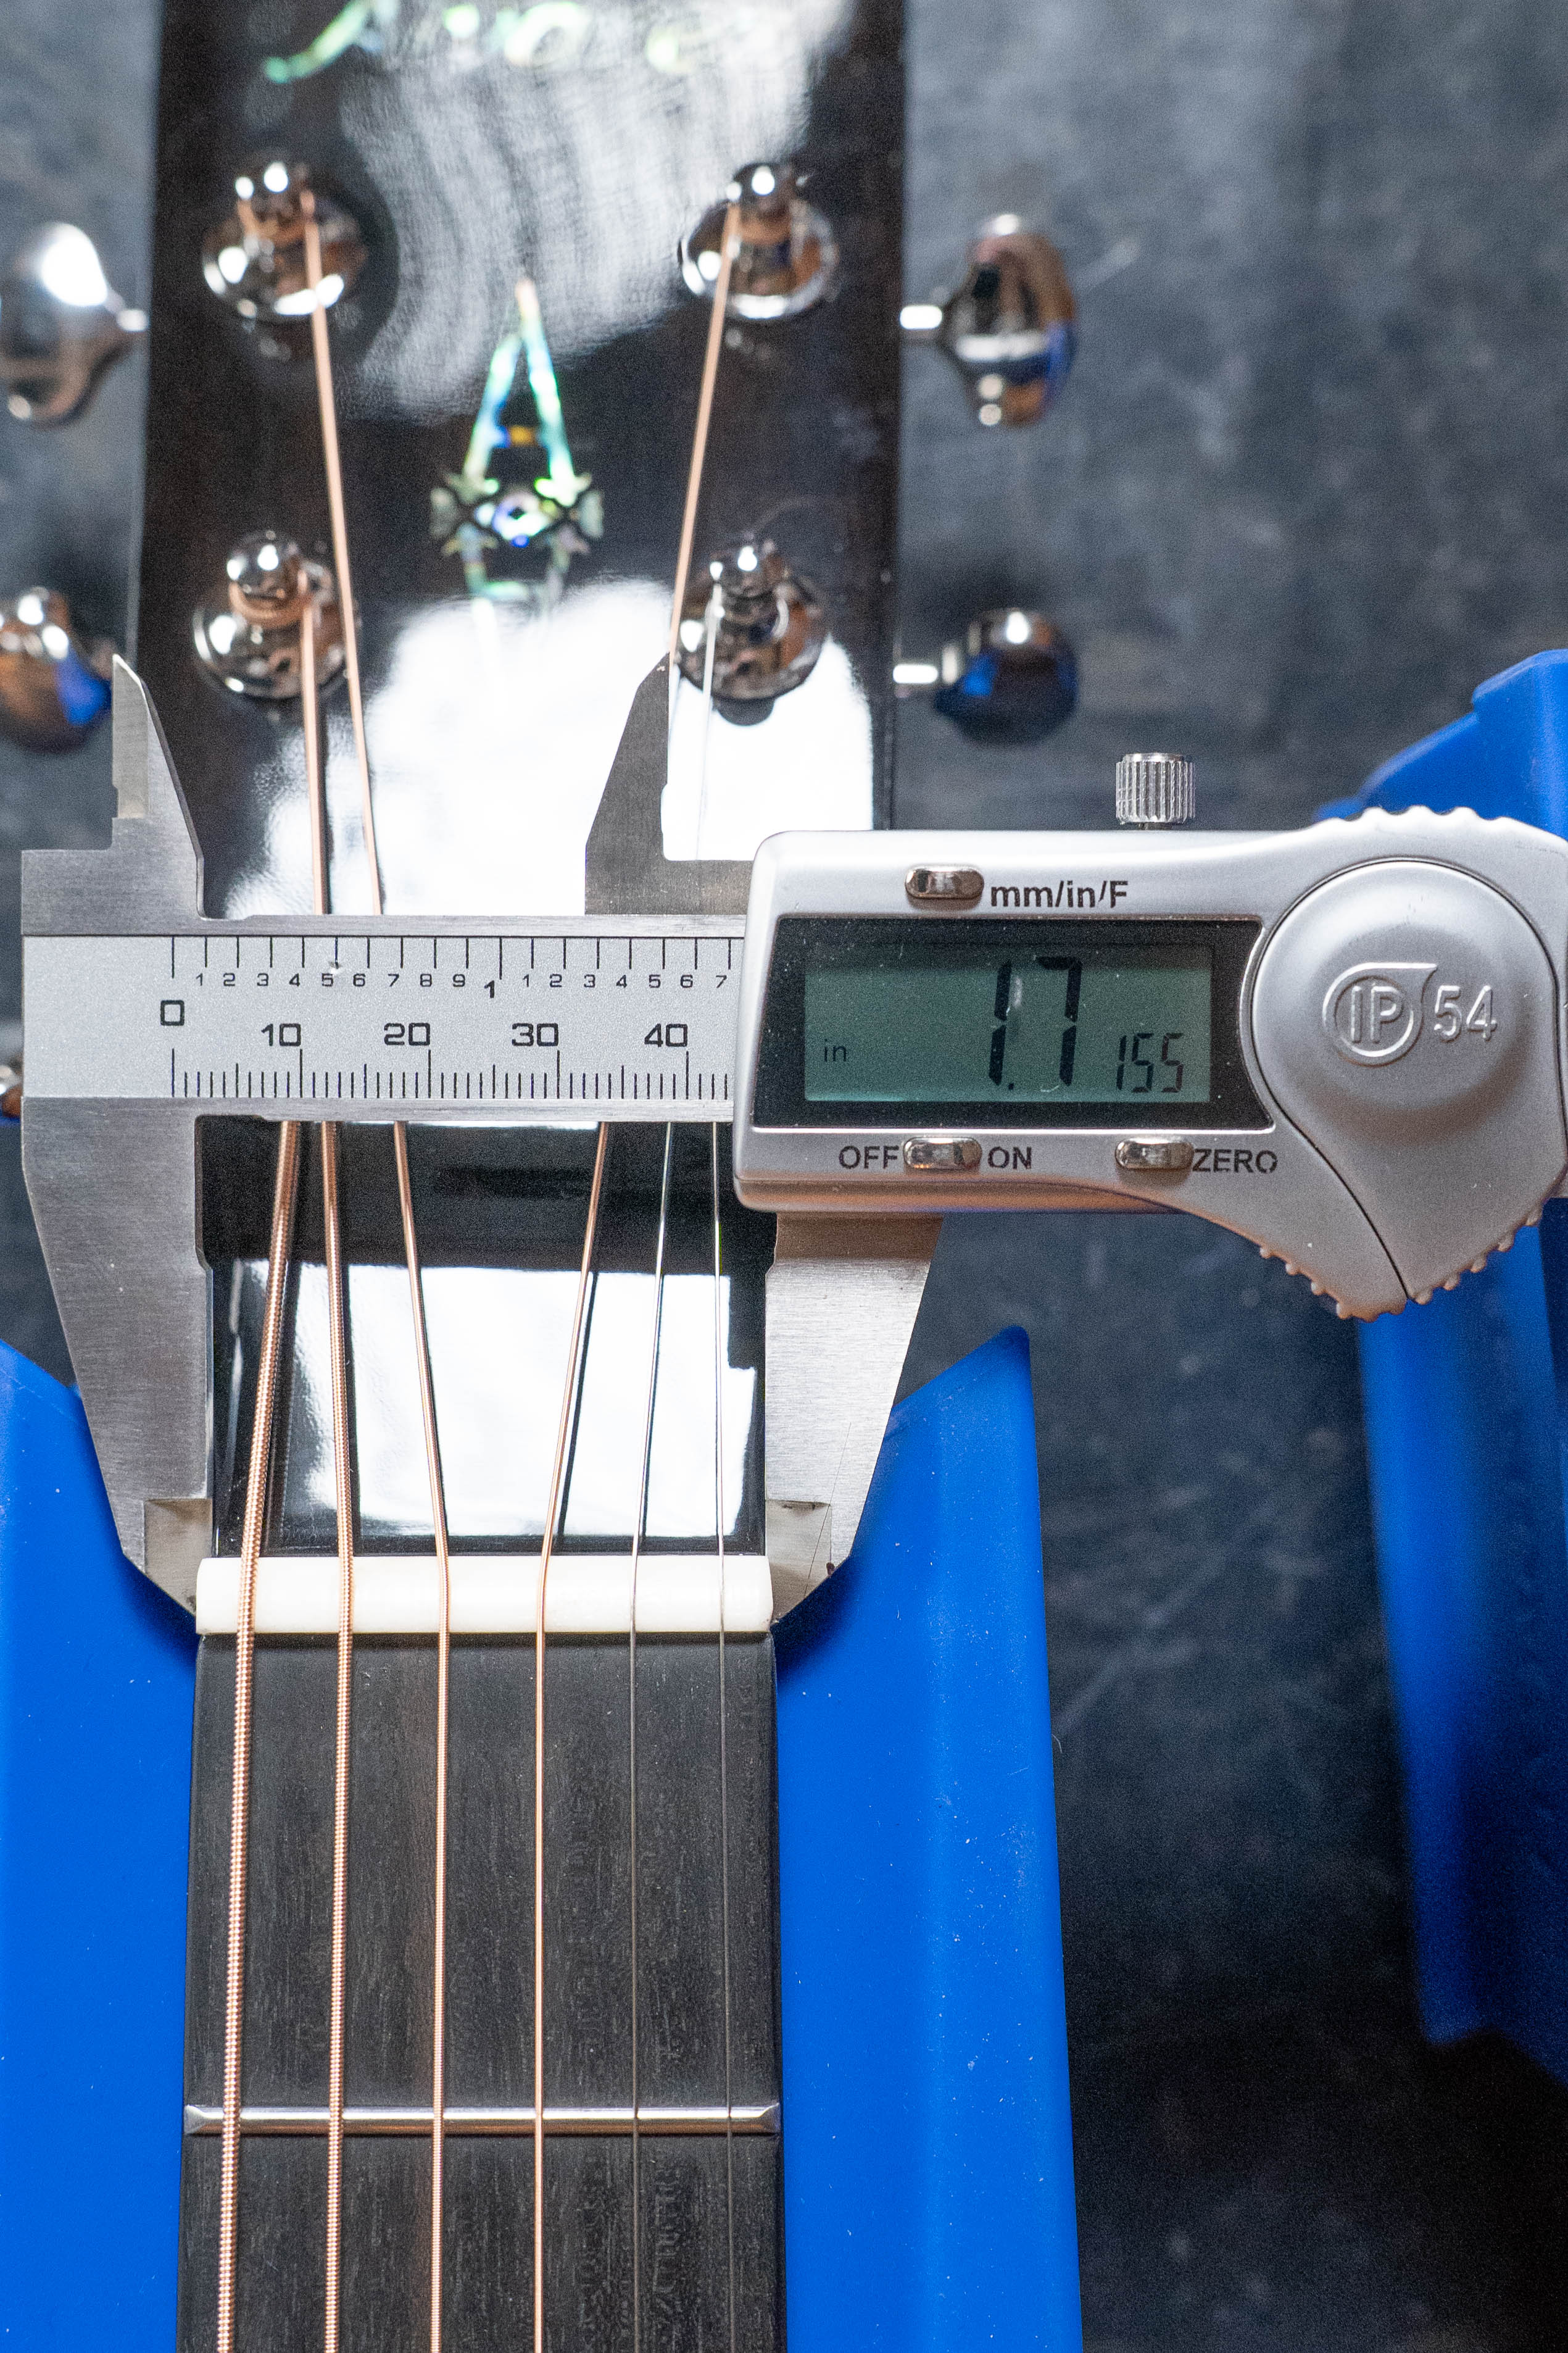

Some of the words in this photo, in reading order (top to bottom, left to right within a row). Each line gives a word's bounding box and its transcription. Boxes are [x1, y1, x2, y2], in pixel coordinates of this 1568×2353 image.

[990, 880, 1129, 909] mm/in/F
[195, 972, 204, 986] 1
[222, 972, 236, 988] 2
[256, 972, 270, 987] 3
[288, 973, 301, 988] 4
[321, 972, 334, 988] 5
[352, 973, 367, 988] 6
[388, 973, 400, 988] 7
[419, 973, 433, 988] 8
[452, 973, 466, 988] 9
[484, 980, 496, 999] 1
[522, 973, 529, 988] 1
[549, 973, 563, 988] 2
[583, 973, 596, 988] 3
[615, 974, 628, 989] 4
[648, 973, 662, 989] 5
[679, 974, 694, 989] 6
[715, 974, 728, 989] 7
[159, 999, 185, 1027] 0
[260, 1023, 302, 1047] 10
[383, 1022, 431, 1047] 20
[511, 1022, 559, 1047] 30
[644, 1023, 688, 1048] 40
[1349, 984, 1404, 1044] IP
[1433, 984, 1498, 1043] 54
[823, 1040, 848, 1063] in
[837, 1144, 899, 1170] OFF
[987, 1146, 1032, 1170] ON
[1192, 1146, 1279, 1175] ZERO
